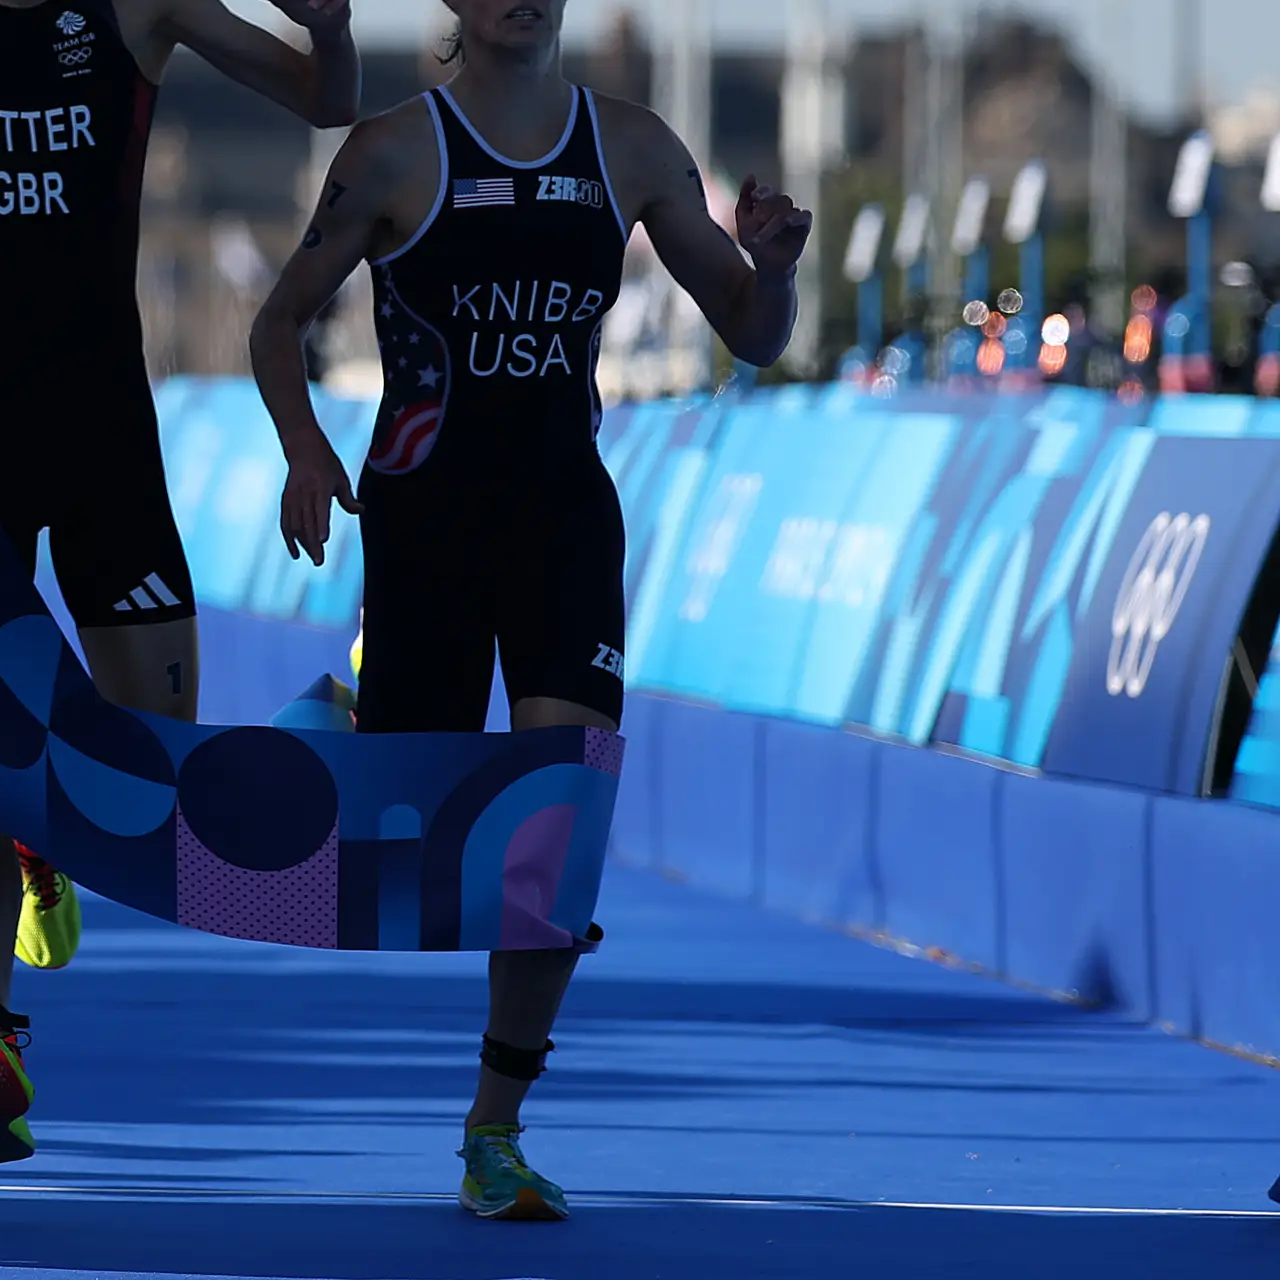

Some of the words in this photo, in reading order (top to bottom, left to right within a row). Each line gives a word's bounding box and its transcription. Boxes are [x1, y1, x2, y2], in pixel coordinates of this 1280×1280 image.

[53, 38, 79, 51] TEAM
[452, 281, 603, 321] KNIBB
[469, 332, 571, 376] USA
[167, 661, 181, 694] 1
